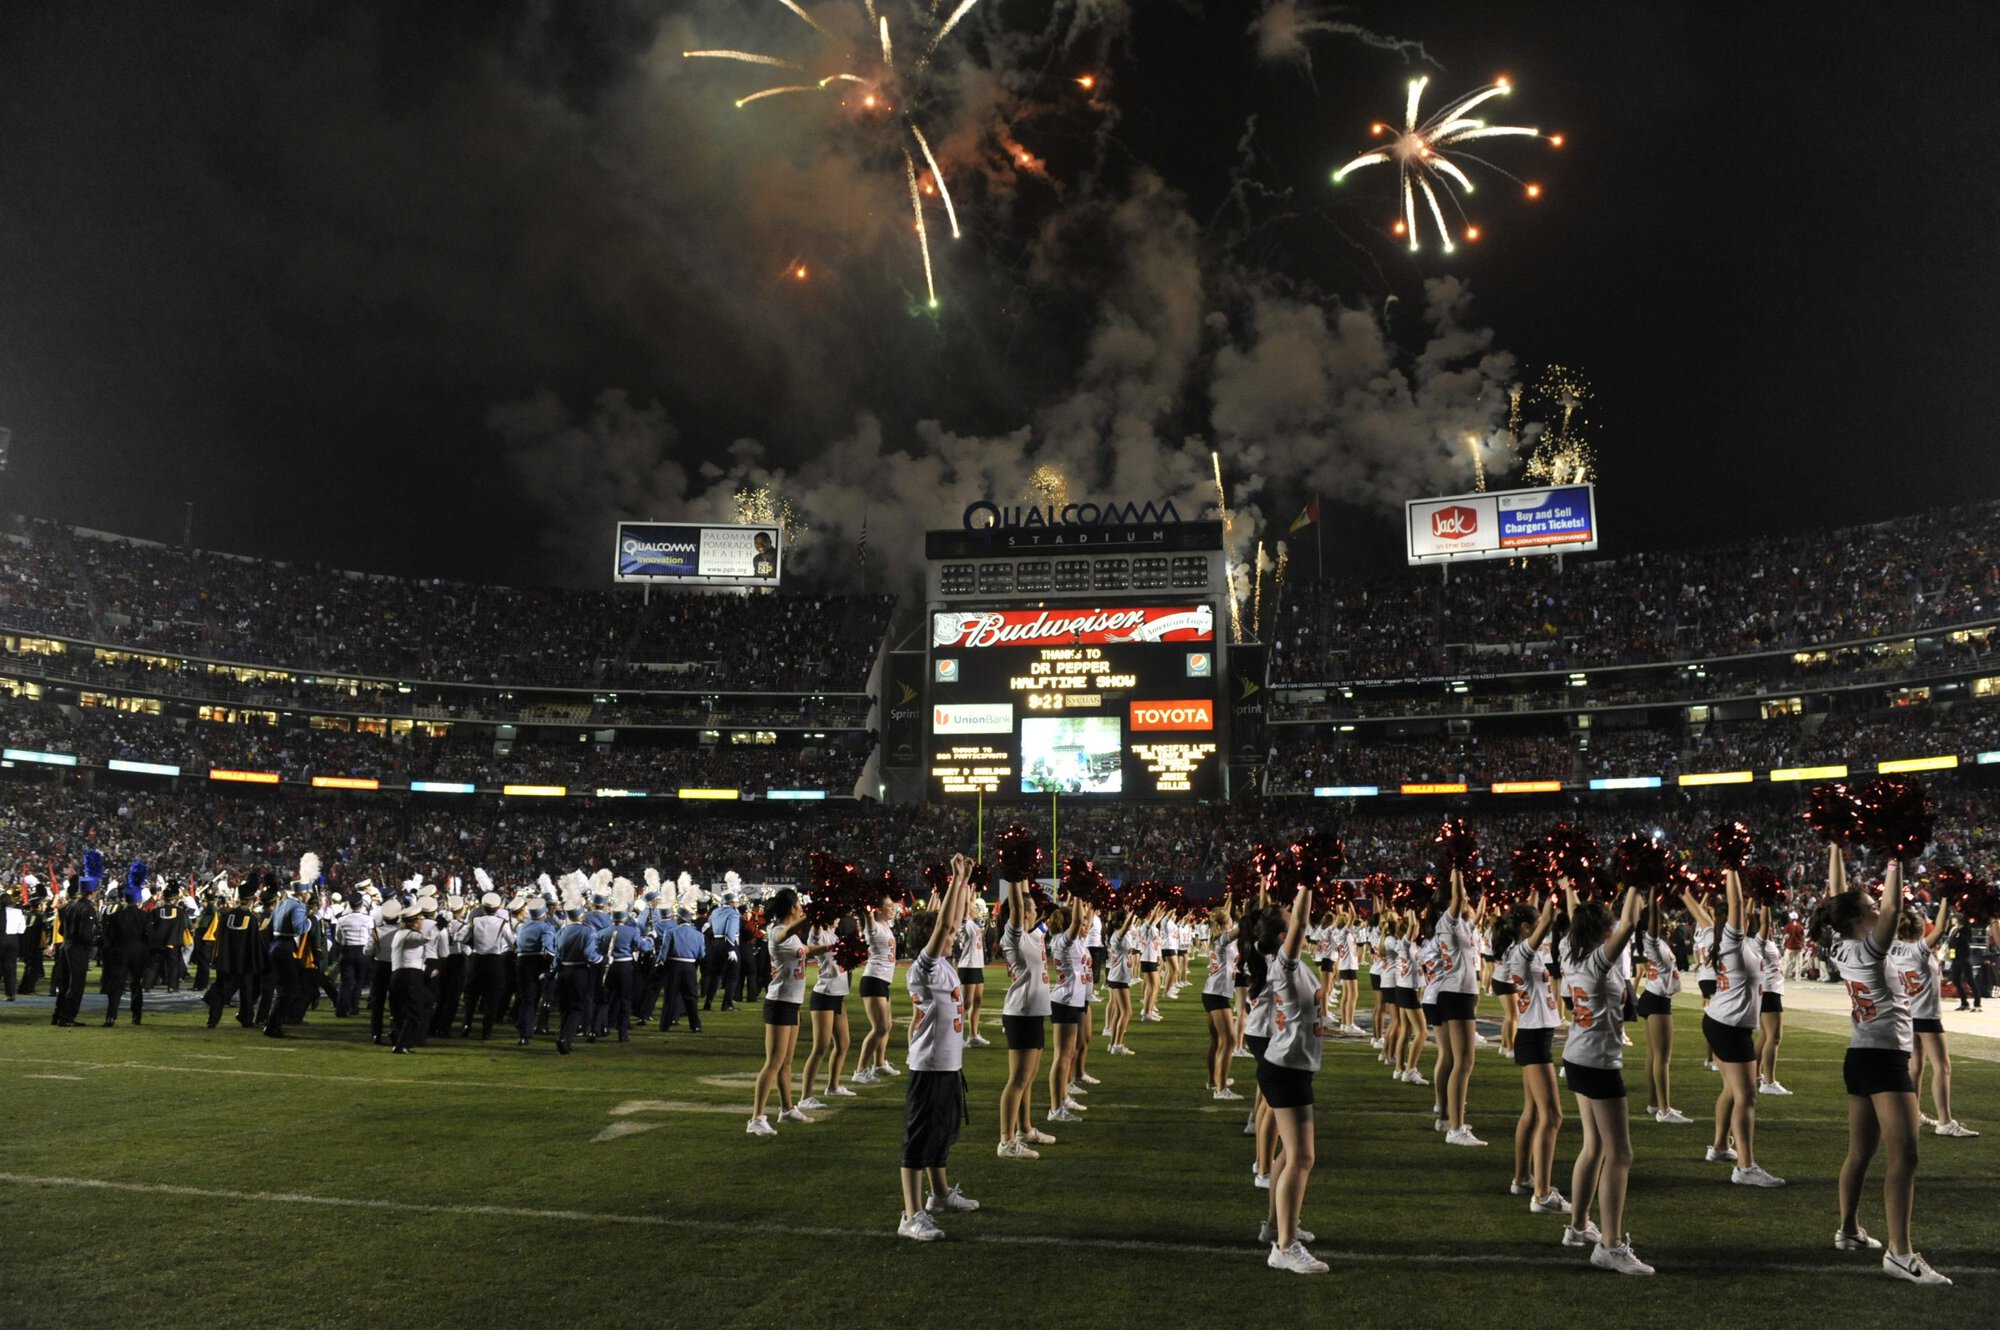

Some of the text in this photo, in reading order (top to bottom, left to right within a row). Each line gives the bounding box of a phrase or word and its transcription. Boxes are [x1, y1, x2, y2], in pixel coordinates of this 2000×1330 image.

[1516, 507, 1571, 522] Buy and Sell
[963, 500, 1181, 544] QUALCOMM
[1434, 512, 1475, 536] Jack
[1505, 518, 1584, 534] Chargers Tickets!
[704, 541, 753, 549] POMERADO
[1008, 531, 1163, 546] STADIUM
[623, 540, 695, 556] QUALCOMM
[703, 550, 752, 558] HEALTH
[637, 556, 683, 564] Innovation
[707, 567, 748, 575] www.pph.org
[960, 608, 1145, 647] Budweiser
[1041, 649, 1101, 659] THANKS TO
[1031, 662, 1110, 674] DR PEPPER
[1011, 675, 1136, 689] HALFTIME SHOW
[1066, 696, 1100, 704] SYCUAN
[954, 714, 1010, 724] UnionBank
[1134, 708, 1209, 724] TOYOTA
[160, 907, 177, 919] U
[227, 914, 250, 931] U
